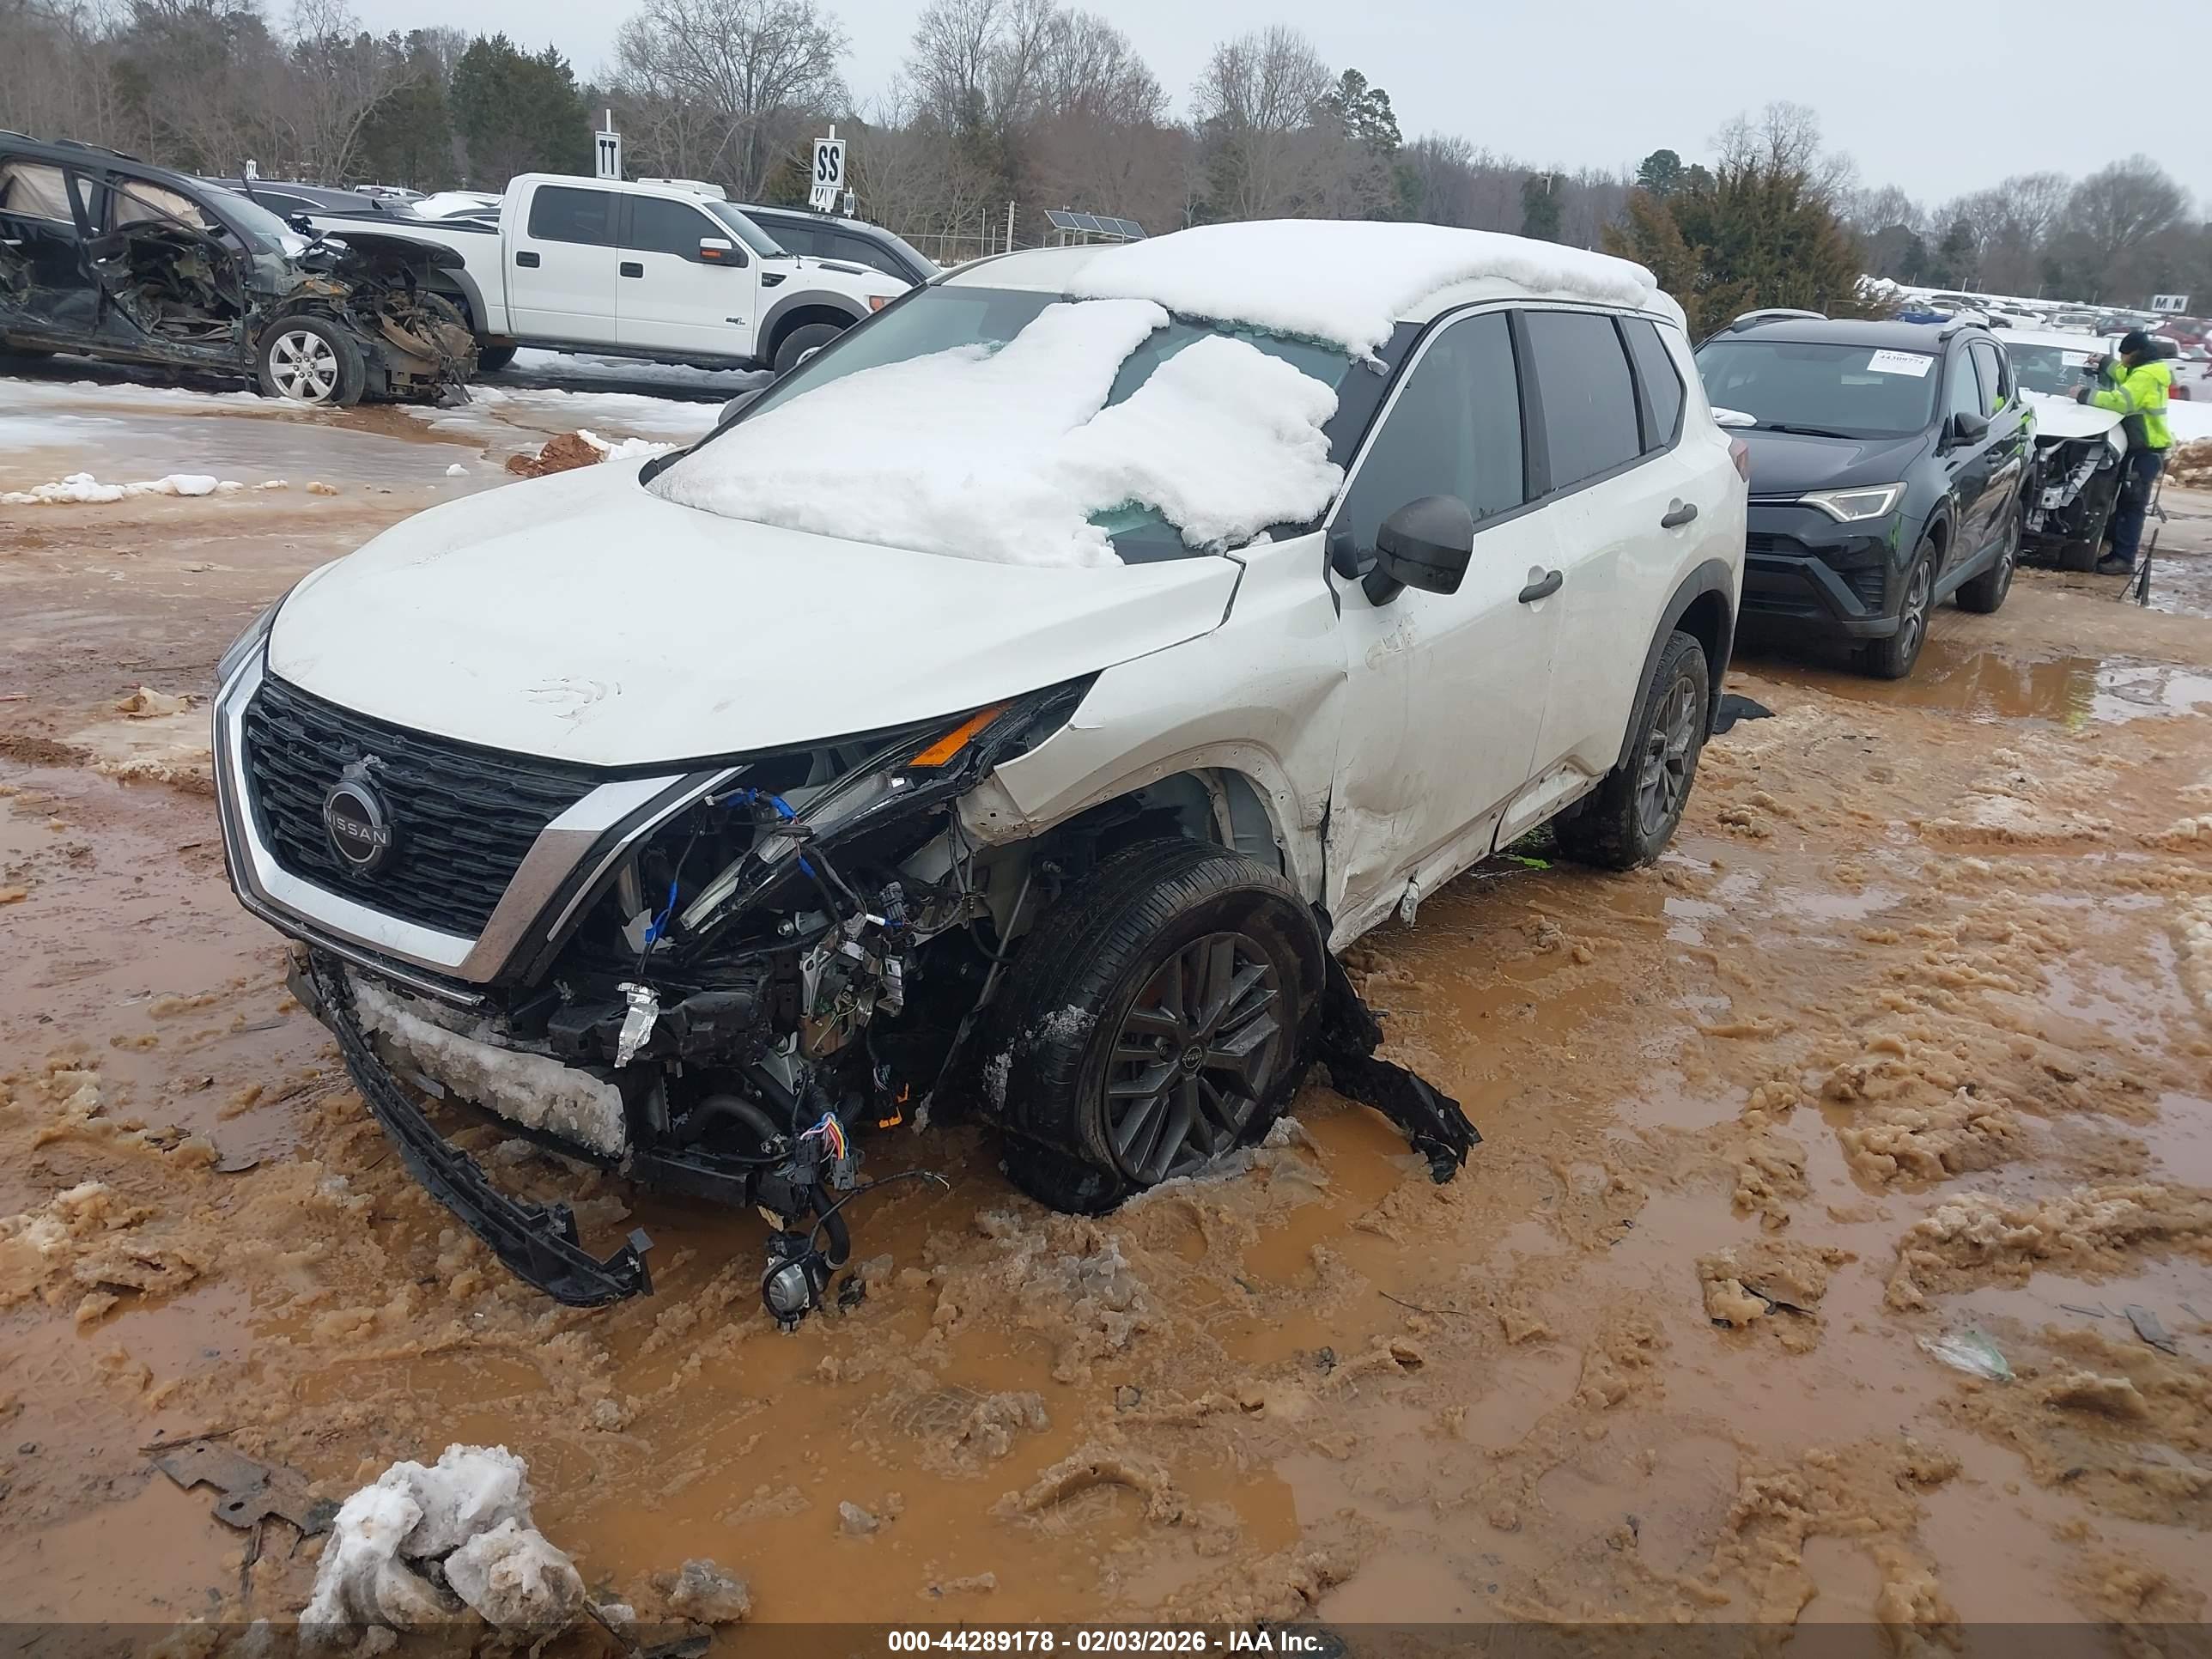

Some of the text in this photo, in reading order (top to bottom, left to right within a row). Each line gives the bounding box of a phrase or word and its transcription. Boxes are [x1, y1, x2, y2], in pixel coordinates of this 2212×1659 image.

[599, 139, 617, 175] TT
[817, 145, 840, 183] SS
[2154, 296, 2185, 310] M N
[324, 808, 386, 845] NISSAN
